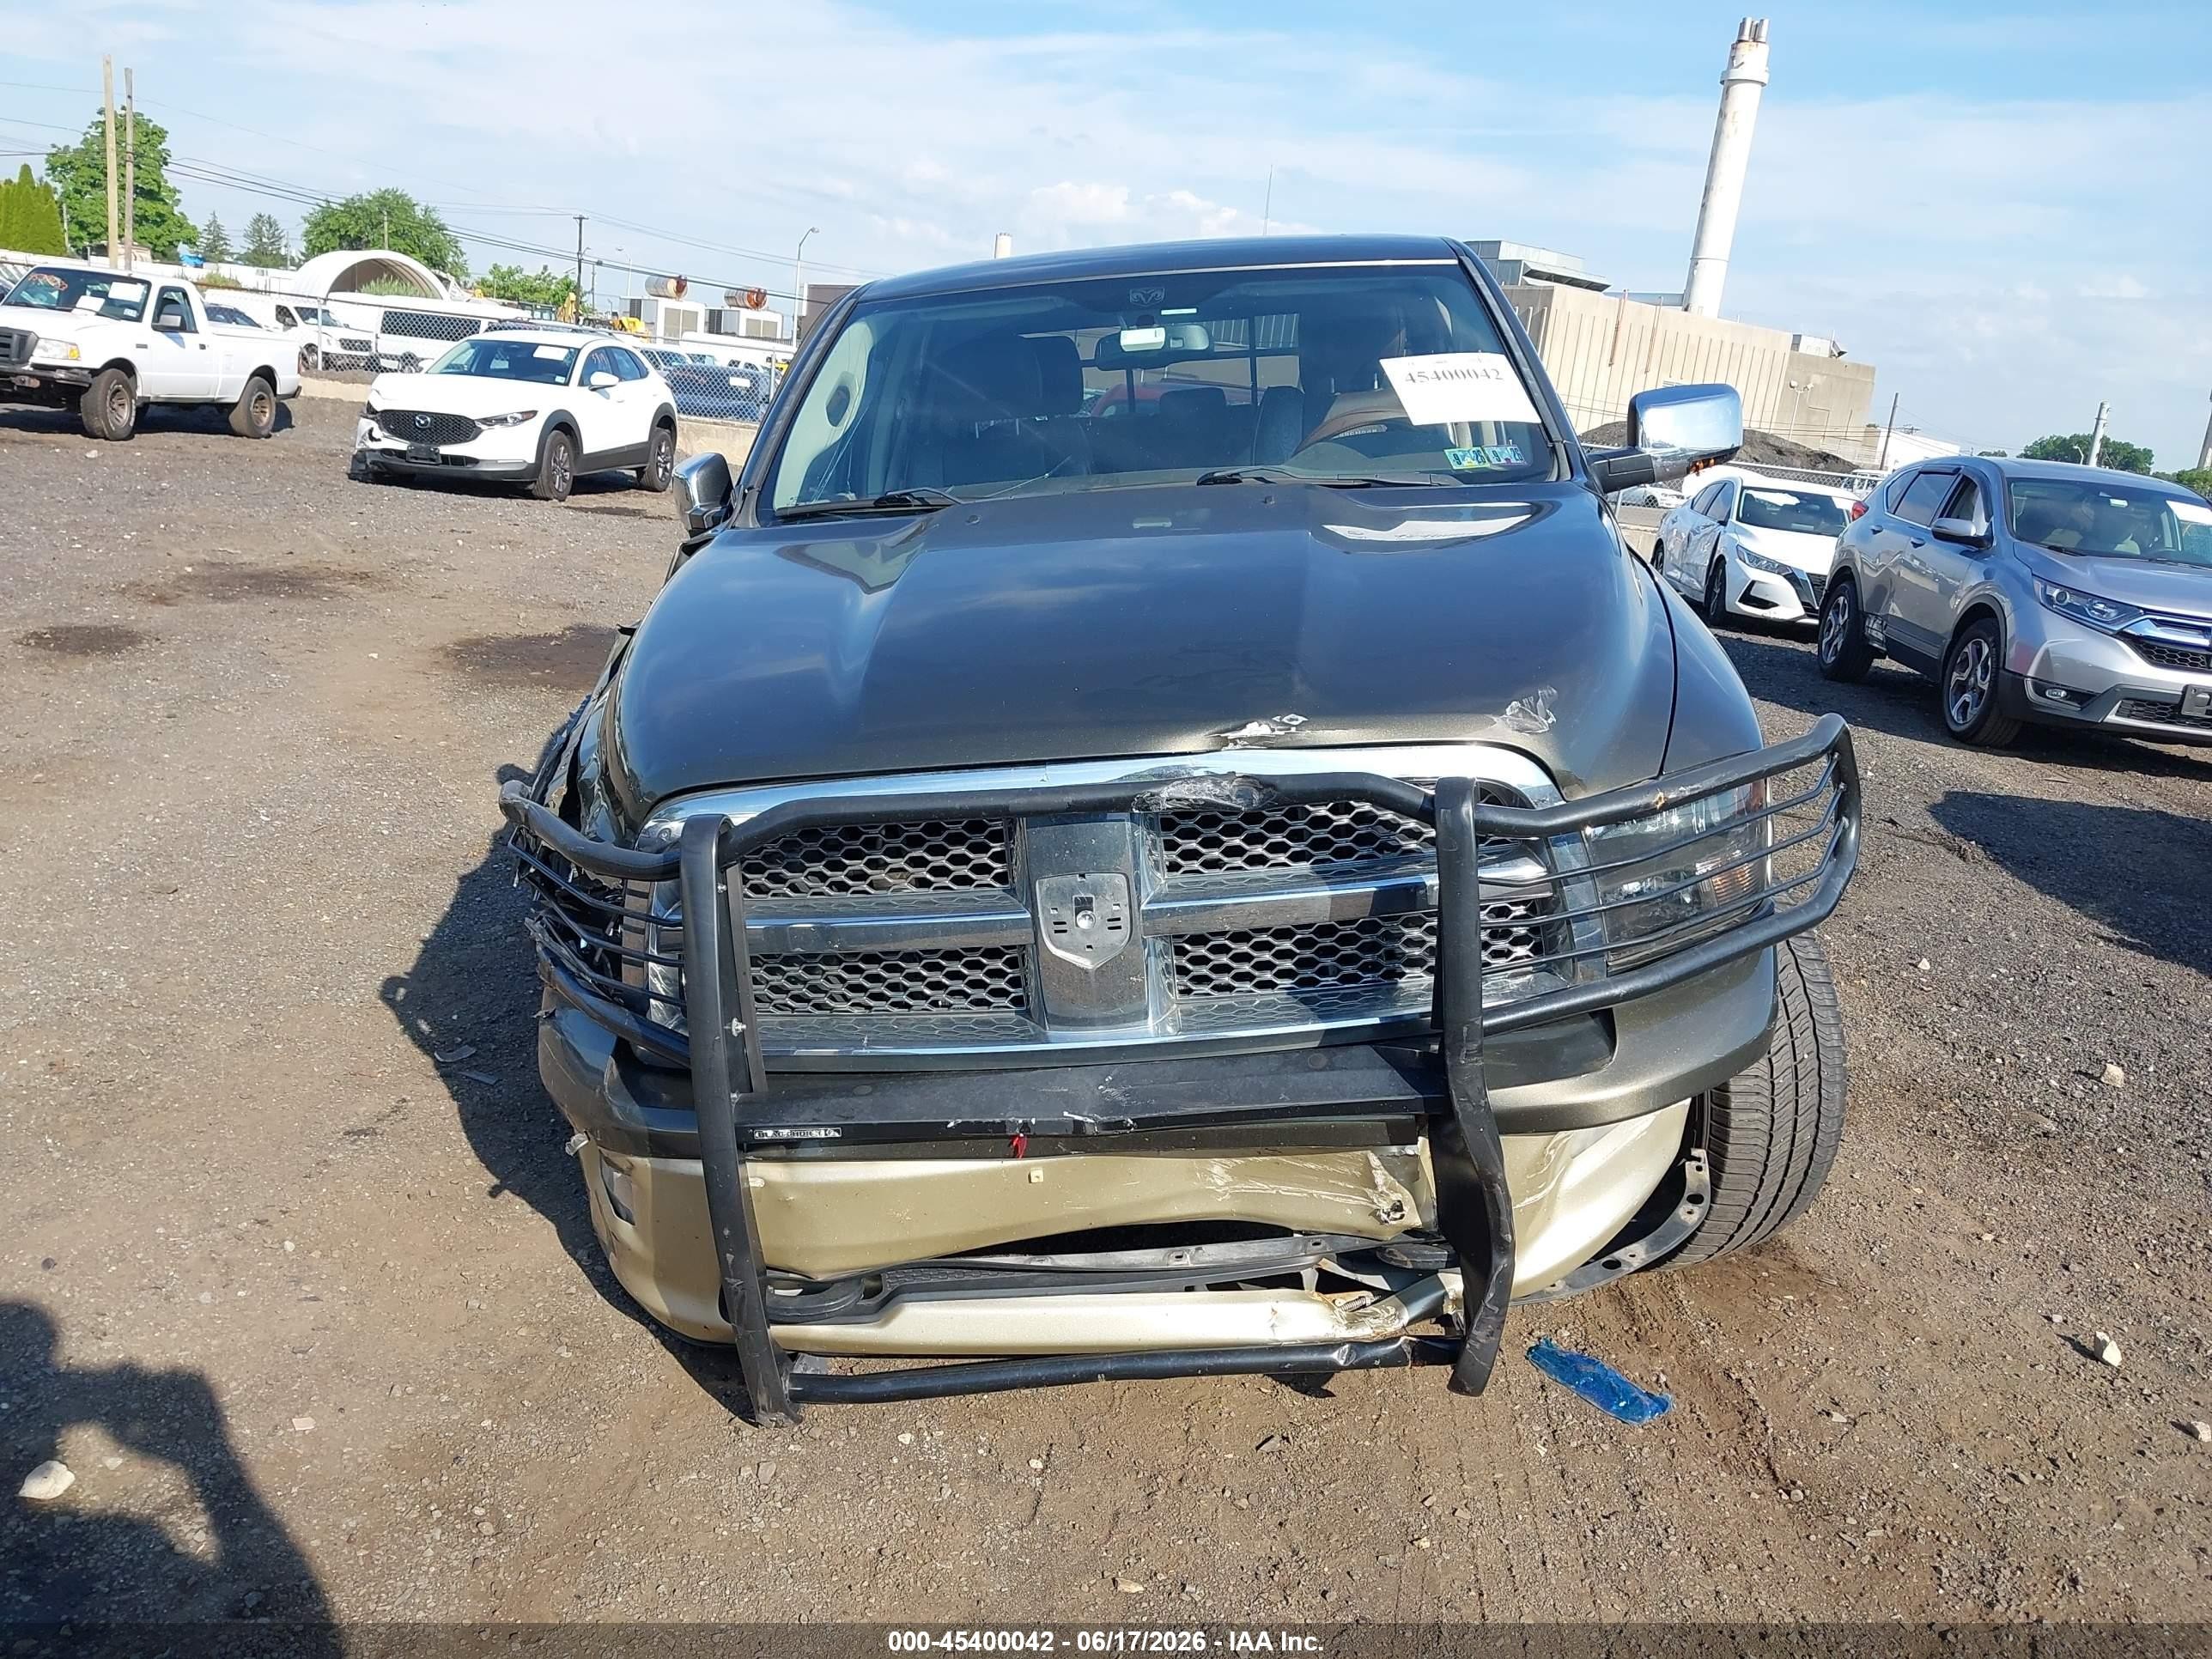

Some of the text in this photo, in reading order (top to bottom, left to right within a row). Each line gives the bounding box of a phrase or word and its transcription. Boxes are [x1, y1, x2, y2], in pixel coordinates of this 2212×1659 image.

[1405, 368, 1504, 383] 45400042
[1452, 450, 1486, 465] 9 26
[1492, 448, 1523, 462] 9 26
